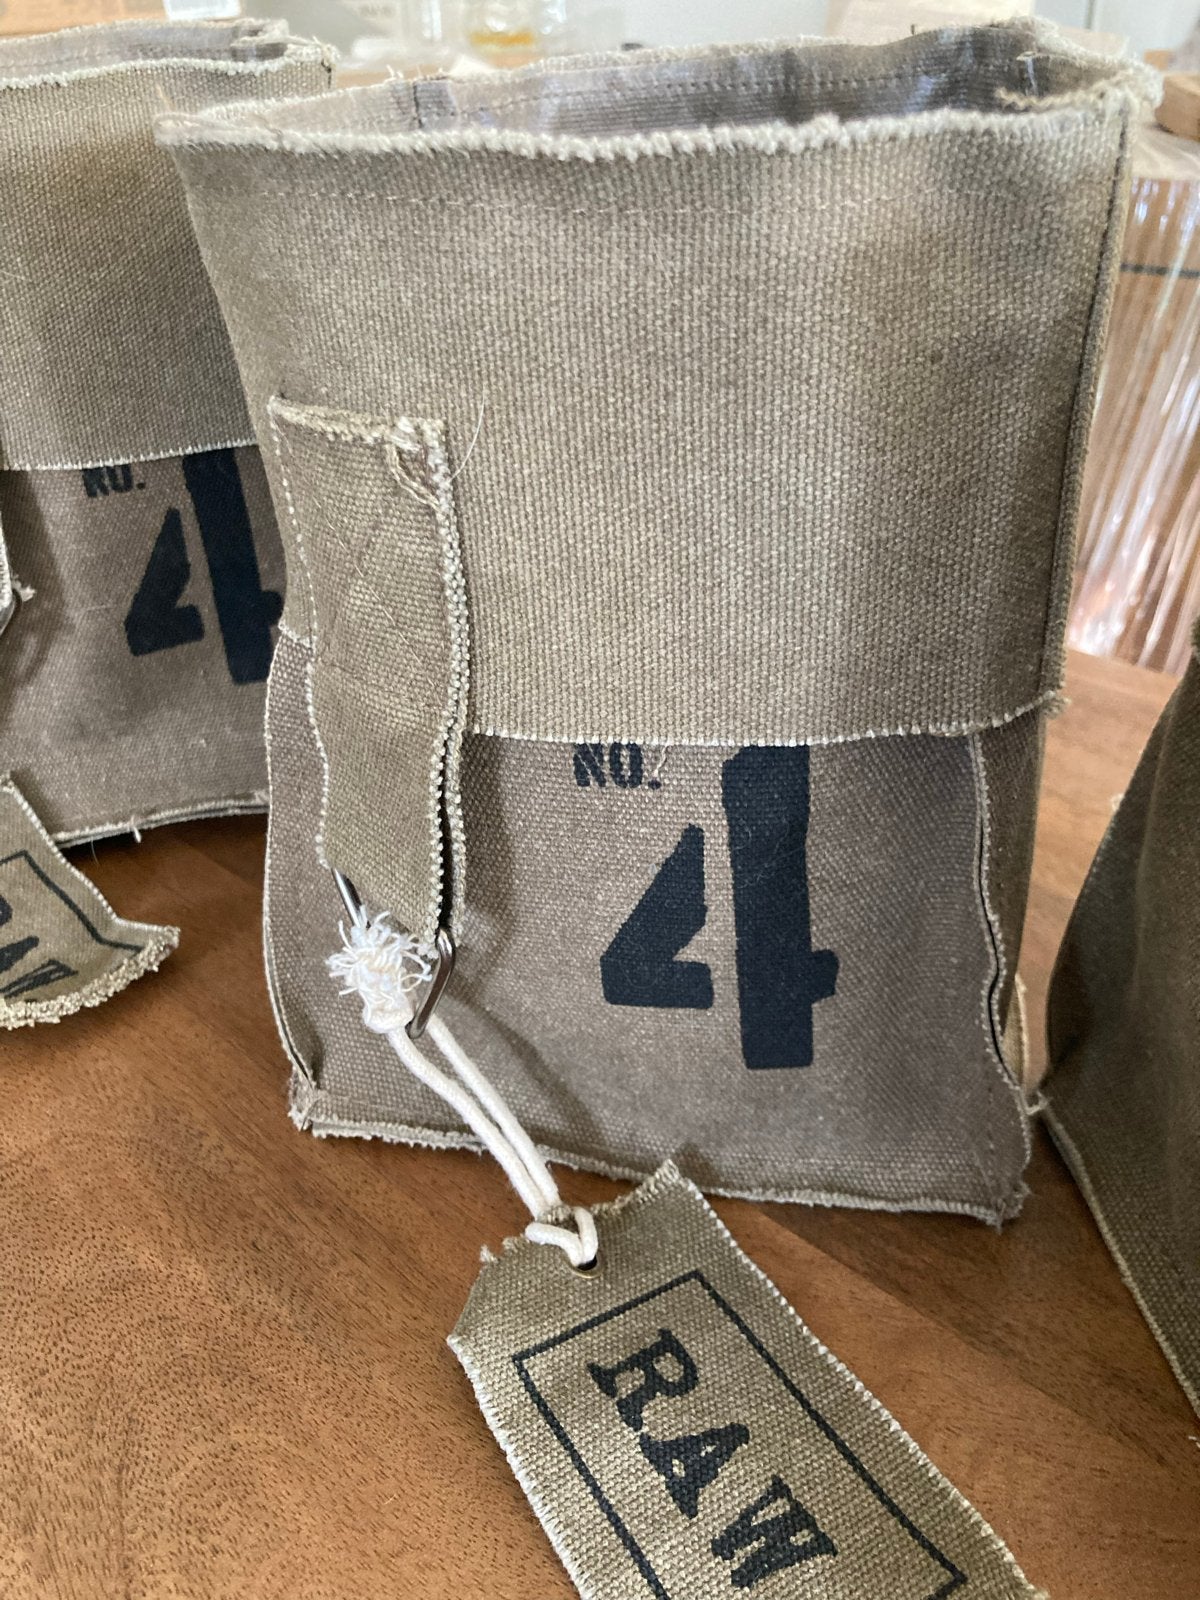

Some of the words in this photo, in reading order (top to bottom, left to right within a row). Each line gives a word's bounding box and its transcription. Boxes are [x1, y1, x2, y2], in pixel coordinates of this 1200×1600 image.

[124, 446, 283, 685] 4
[573, 742, 661, 789] NO.
[600, 745, 839, 1069] 4
[587, 1329, 838, 1588] RAW
